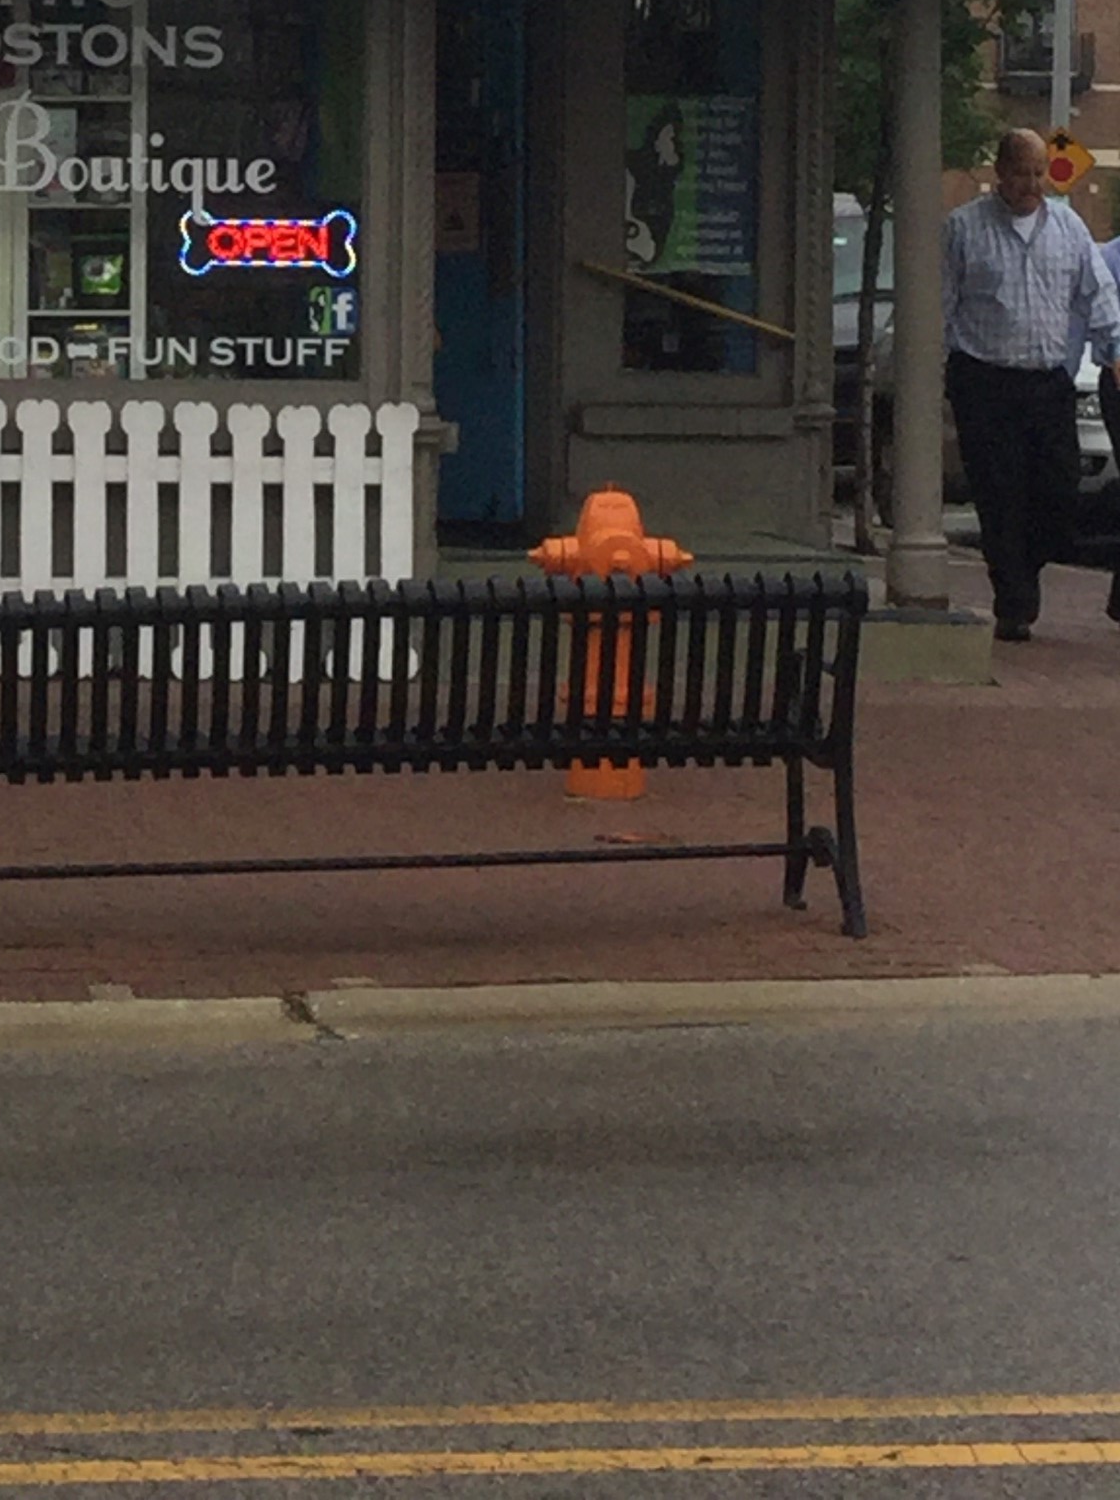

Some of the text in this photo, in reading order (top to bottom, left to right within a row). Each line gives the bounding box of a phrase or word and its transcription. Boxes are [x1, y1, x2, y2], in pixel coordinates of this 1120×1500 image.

[206, 224, 332, 261] OPEN
[107, 337, 198, 367] FUN
[209, 338, 350, 367] STUFF
